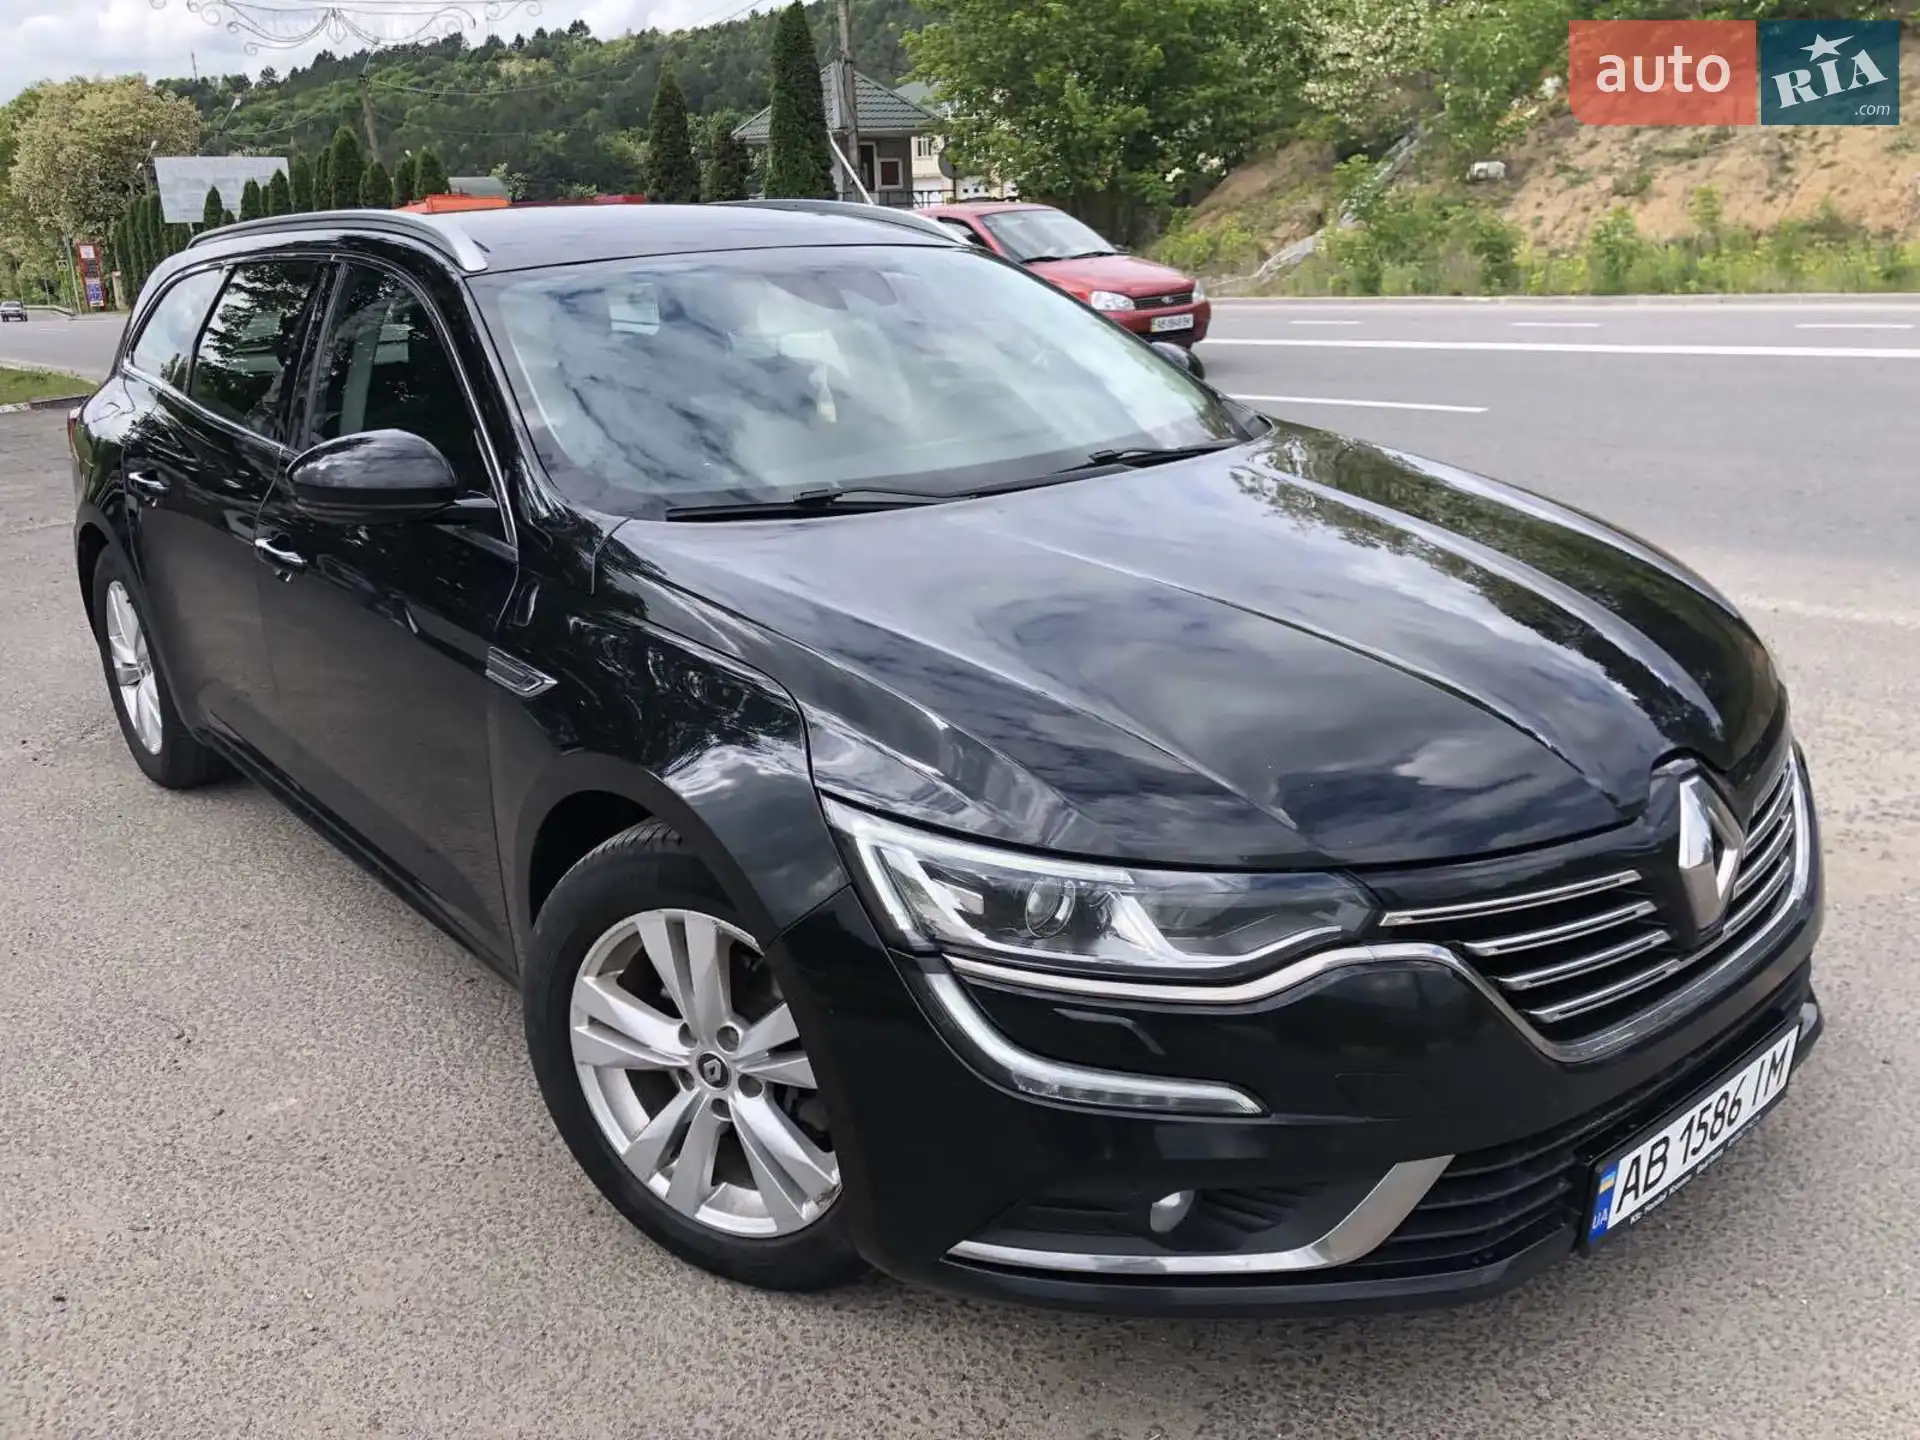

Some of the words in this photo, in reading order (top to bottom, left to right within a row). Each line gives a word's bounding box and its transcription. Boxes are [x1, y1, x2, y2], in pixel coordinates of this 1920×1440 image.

[1615, 1135, 1671, 1214] AB
[1679, 1073, 1749, 1165] 1586
[1751, 1038, 1790, 1106] IM
[1591, 1207, 1609, 1230] UA
